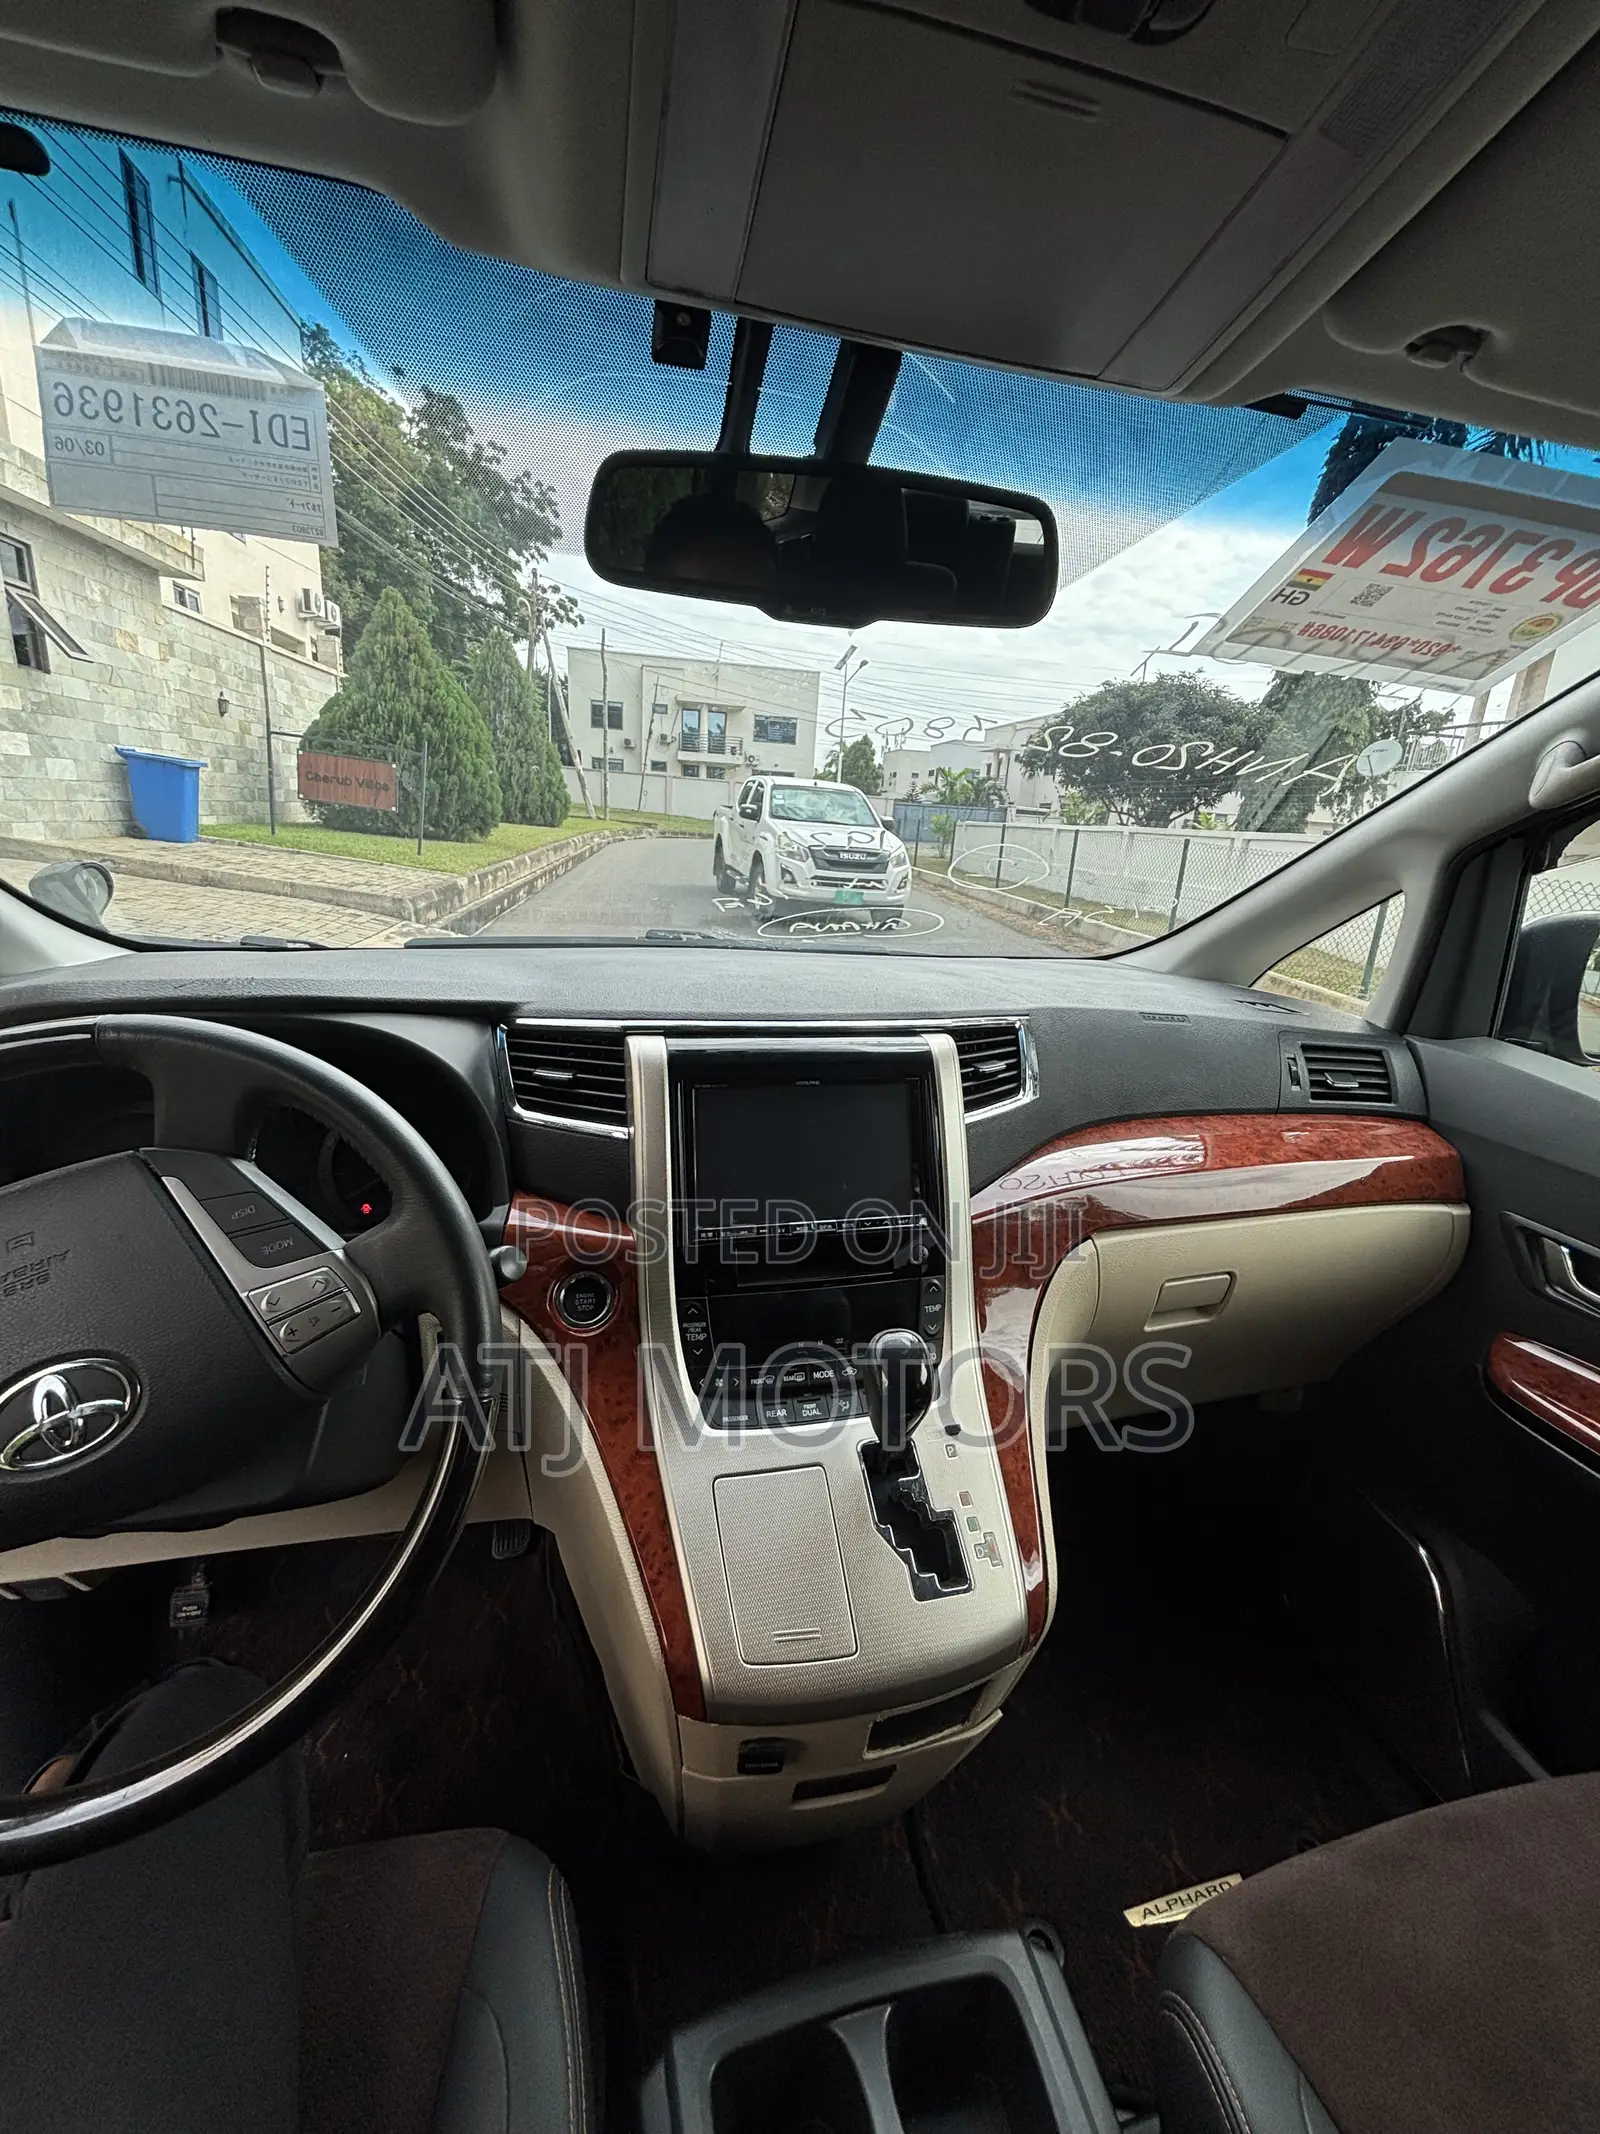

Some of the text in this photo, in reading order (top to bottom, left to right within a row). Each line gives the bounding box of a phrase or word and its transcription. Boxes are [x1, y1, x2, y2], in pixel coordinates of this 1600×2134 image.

[304, 770, 353, 787] Cherub
[837, 852, 868, 860] ISUZU
[231, 1204, 256, 1220] DISP
[260, 1236, 294, 1256] MODE
[574, 1298, 597, 1306] START
[924, 1304, 942, 1313] TEMP
[685, 1333, 708, 1341] TEMP
[812, 1371, 835, 1380] MODE
[765, 1409, 788, 1418] REAR
[801, 1408, 822, 1417] DUAL
[947, 1446, 955, 1456] P
